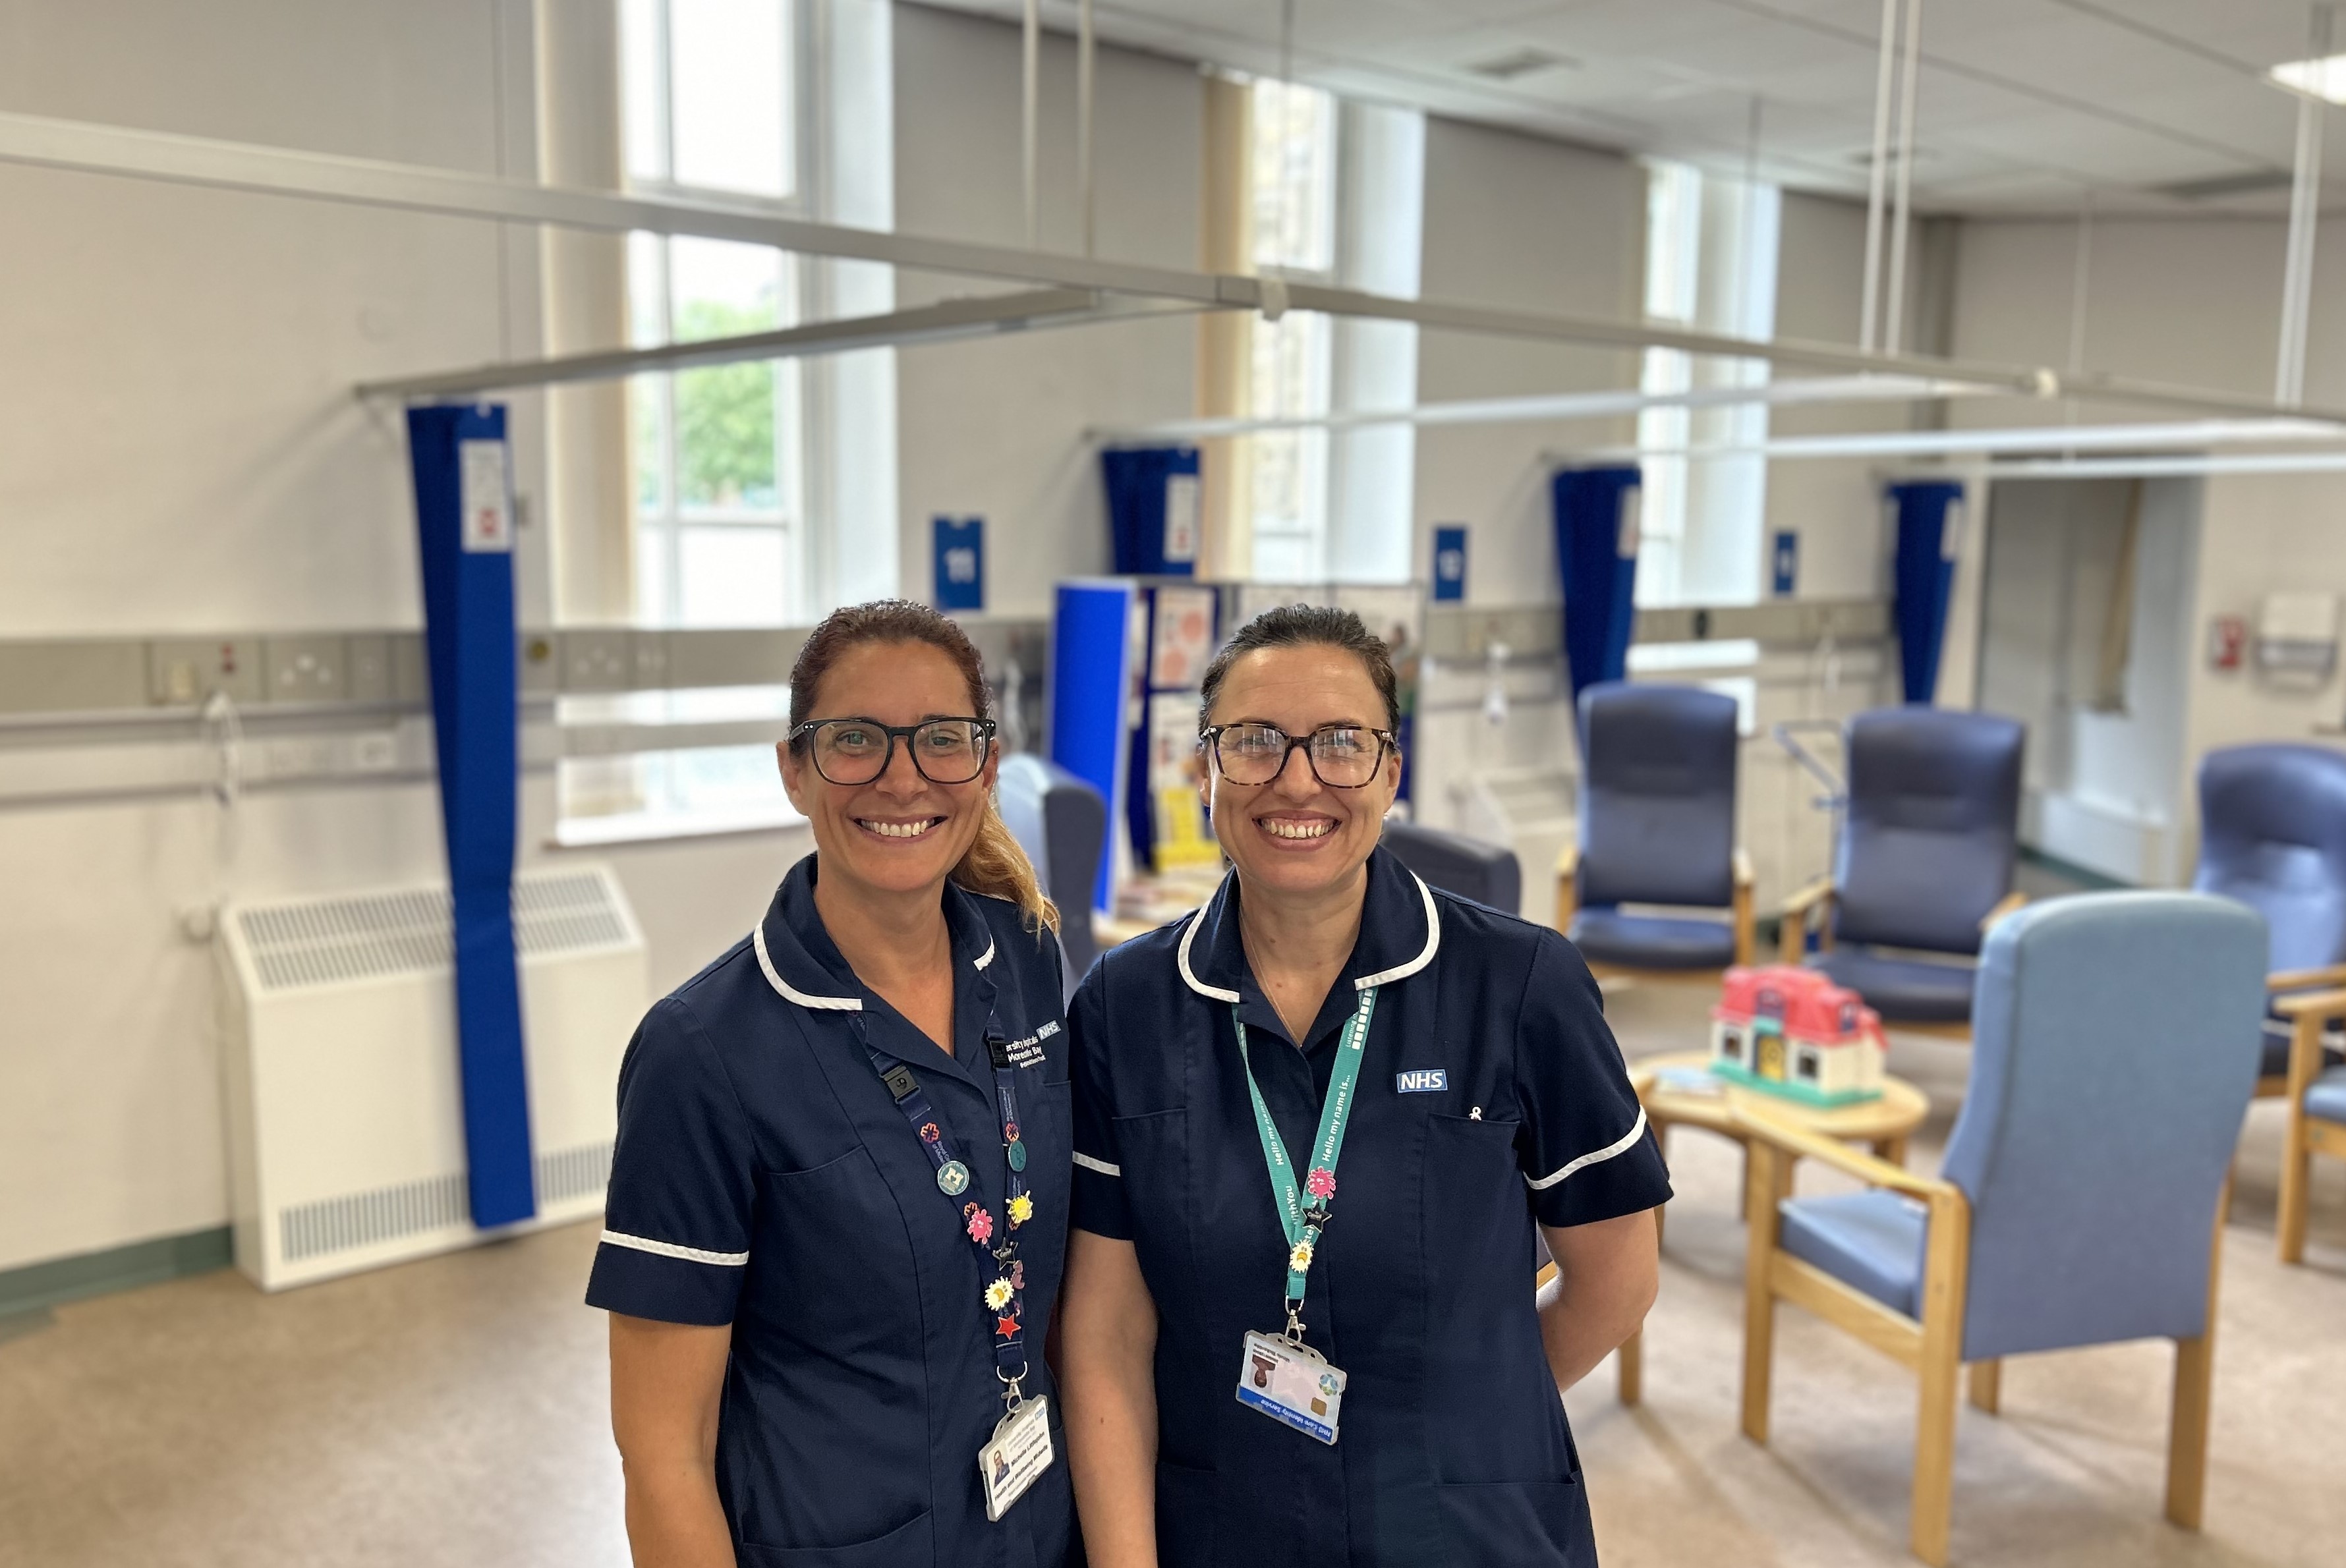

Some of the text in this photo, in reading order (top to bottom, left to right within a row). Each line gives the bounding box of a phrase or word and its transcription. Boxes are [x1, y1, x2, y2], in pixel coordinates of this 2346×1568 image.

[1039, 1022, 1058, 1039] NHS
[1400, 1072, 1443, 1090] NHS
[1334, 1091, 1346, 1118] name
[1267, 1126, 1276, 1140] my
[1330, 1119, 1341, 1134] my
[1271, 1141, 1284, 1165] Hello
[1322, 1136, 1335, 1162] Hello
